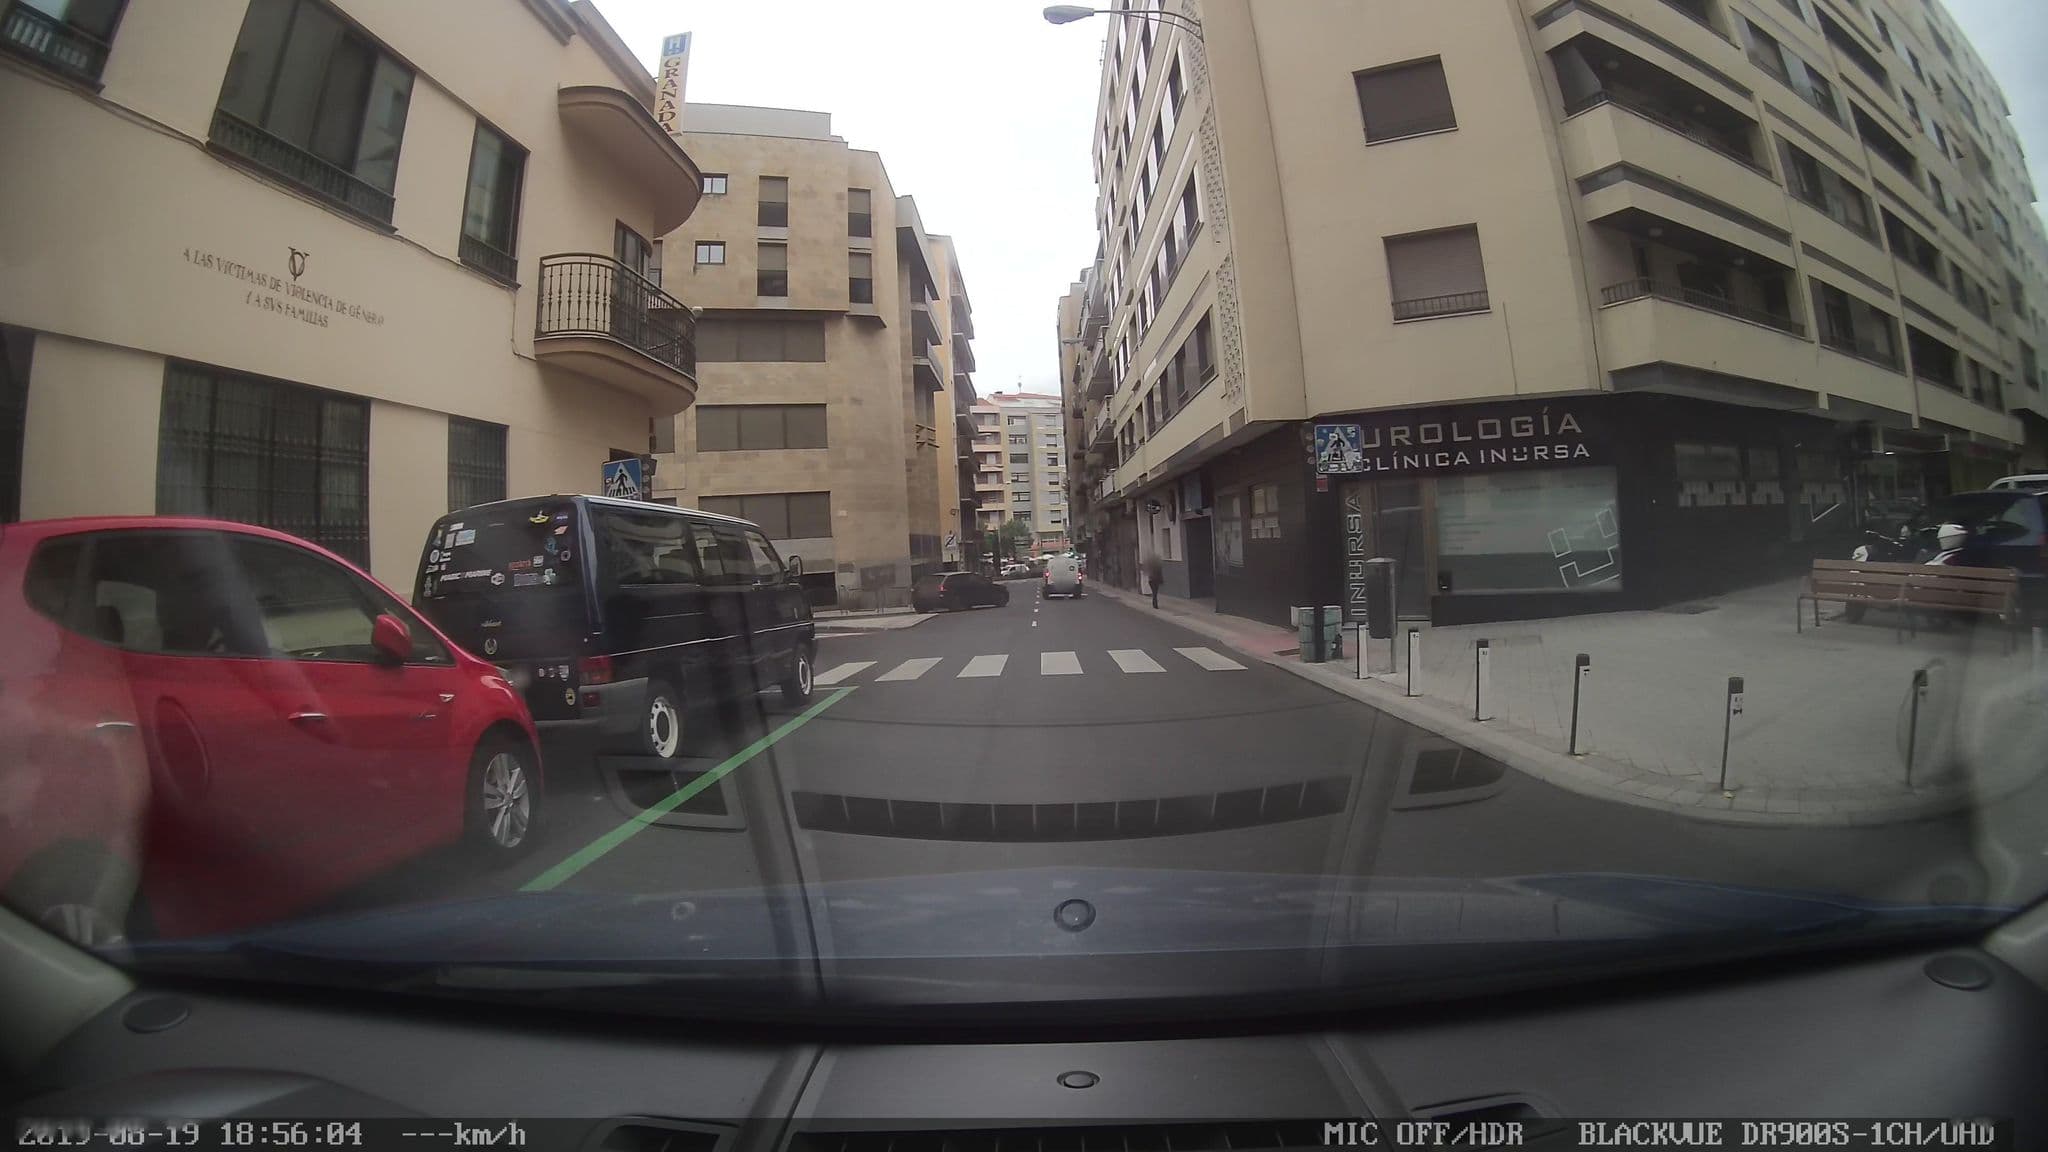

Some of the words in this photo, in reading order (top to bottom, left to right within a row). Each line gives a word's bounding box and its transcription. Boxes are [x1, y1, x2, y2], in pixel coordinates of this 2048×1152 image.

[658, 57, 681, 132] GRANADA
[183, 249, 190, 262] A
[194, 250, 213, 268] LAS
[270, 276, 282, 293] DE
[285, 281, 333, 311] VIOLENCIA
[336, 300, 347, 315] DE
[285, 303, 329, 328] FAMILIAS
[1361, 406, 1583, 449] UROLOGÍA
